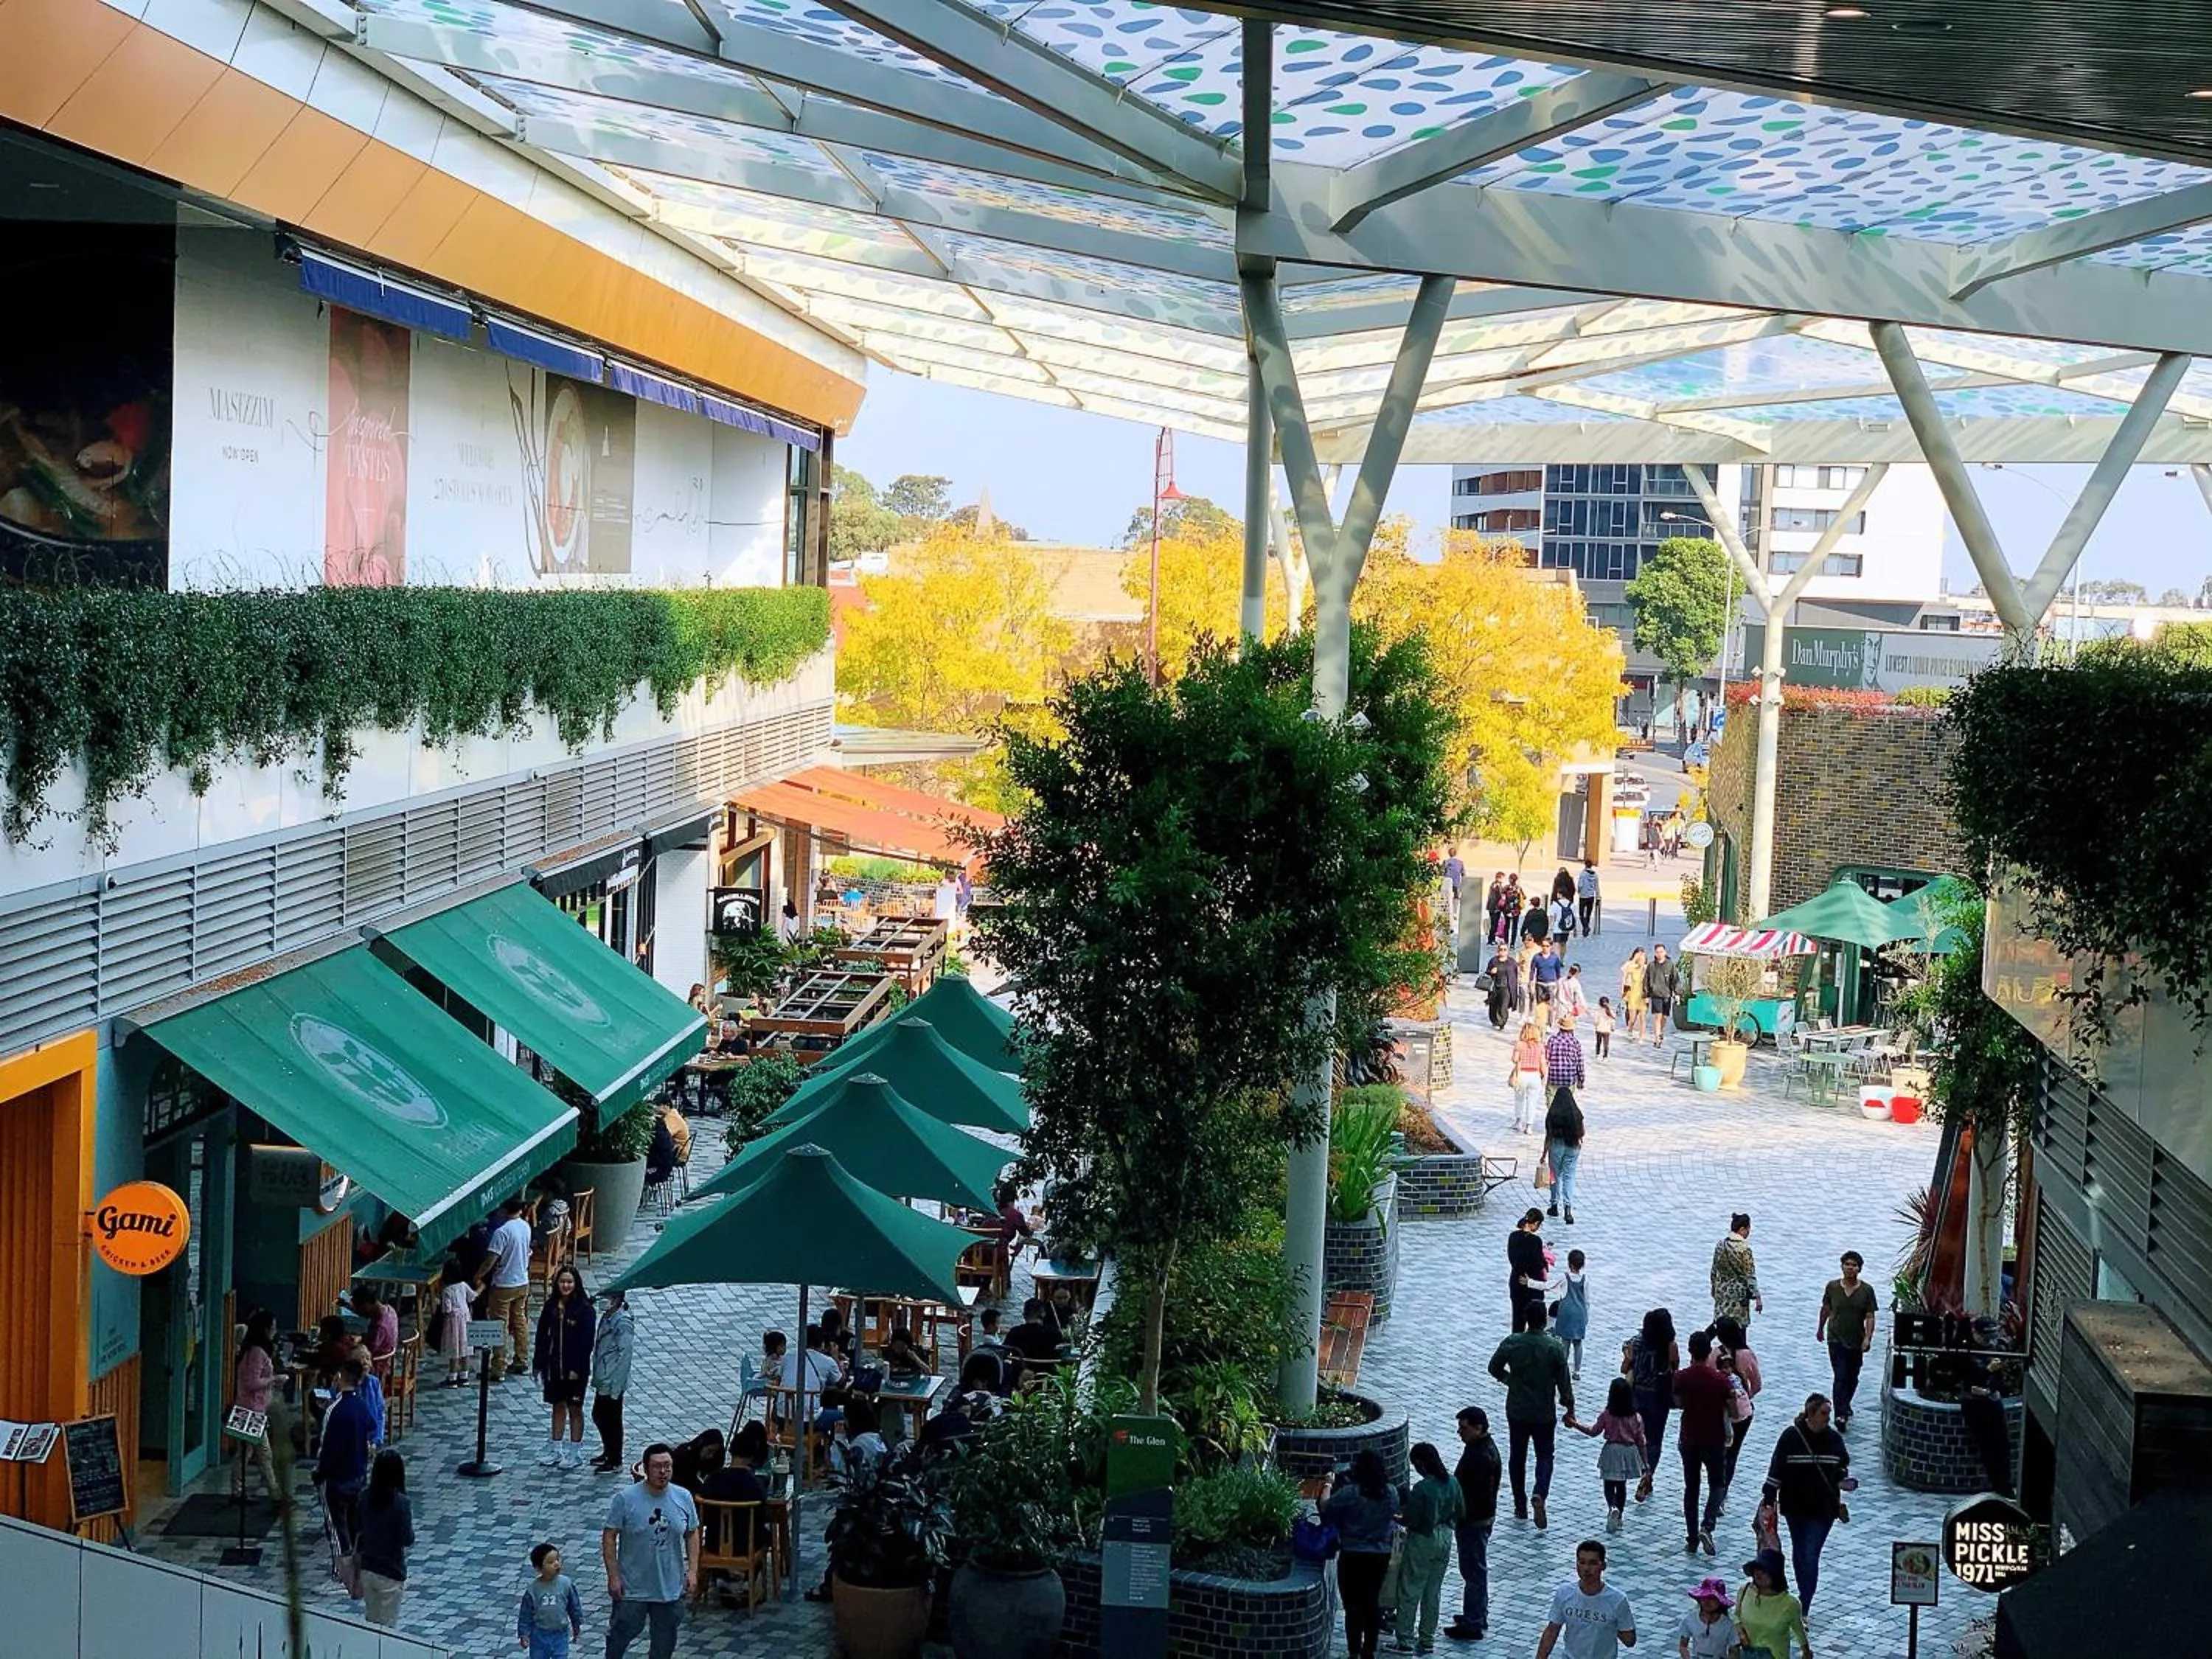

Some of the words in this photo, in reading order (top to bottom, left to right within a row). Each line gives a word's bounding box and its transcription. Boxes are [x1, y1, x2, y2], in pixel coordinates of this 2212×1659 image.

[1792, 639, 1813, 665] Dan
[1814, 639, 1859, 677] Murphy's
[97, 1206, 176, 1239] Gami
[101, 1244, 136, 1267] CHICKEN
[150, 1249, 171, 1266] BEER
[1129, 1435, 1144, 1444] The
[1147, 1436, 1166, 1446] Glen
[1955, 1521, 2005, 1543] MISS
[1955, 1543, 2028, 1564] PICKLE
[1955, 1563, 1994, 1583] 1971
[1565, 1607, 1607, 1623] GUESS
